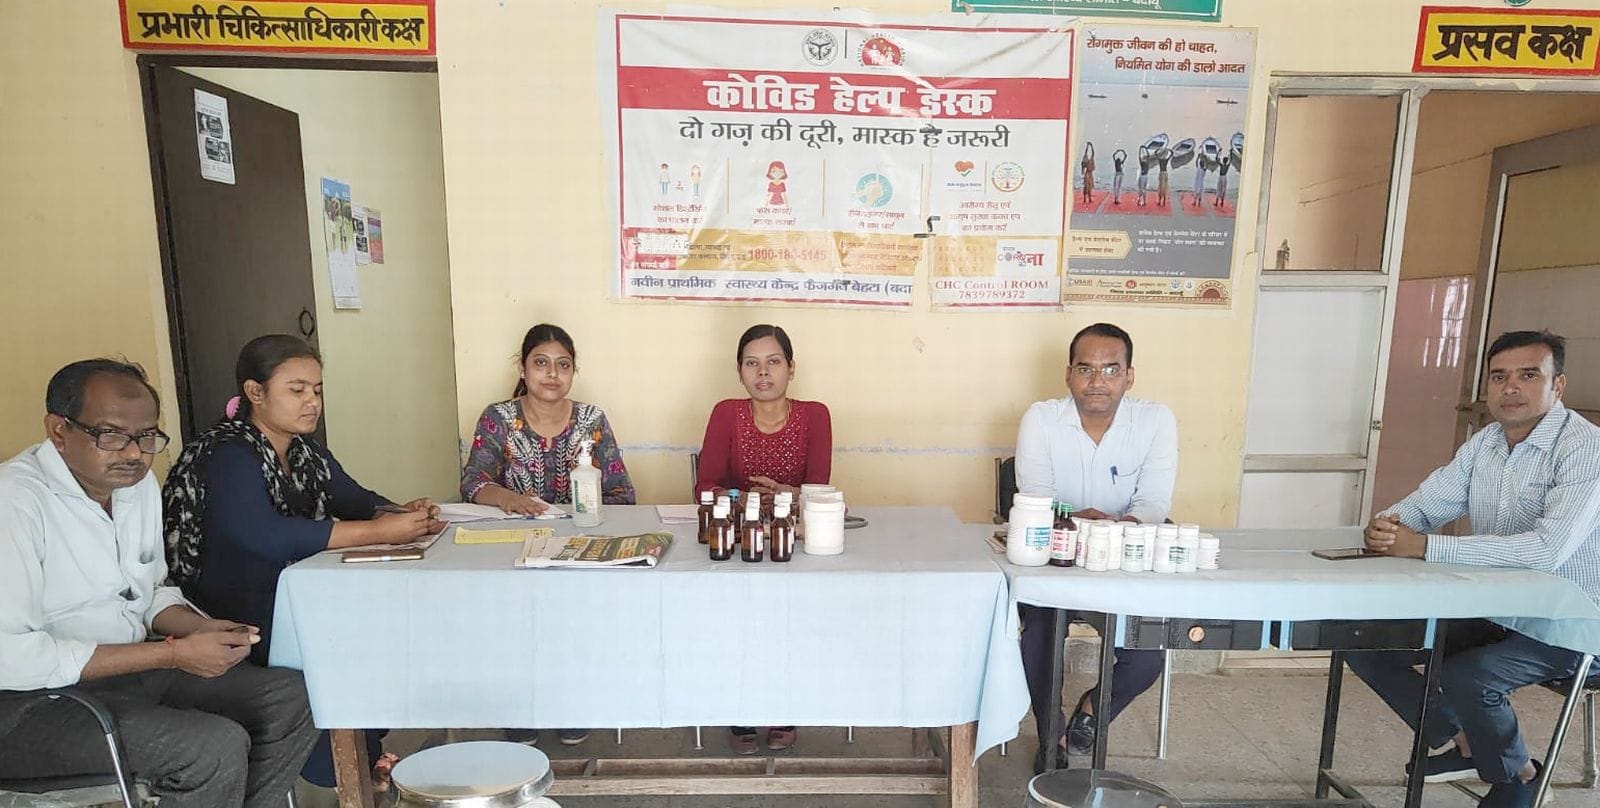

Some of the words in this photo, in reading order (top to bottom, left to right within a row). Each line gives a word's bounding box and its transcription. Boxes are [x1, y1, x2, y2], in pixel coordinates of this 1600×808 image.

[137, 4, 213, 39] प्रभारी
[215, 5, 381, 43] चिकित्साधिकारी
[381, 17, 425, 45] कक्ष
[1087, 36, 1124, 54] रोगमुक्त
[1126, 36, 1156, 51] जीवन
[1158, 37, 1172, 52] की
[1175, 38, 1185, 53] हो
[1188, 42, 1217, 54] चाहत,
[1432, 25, 1526, 61] प्रसव
[1527, 25, 1593, 64] कक्ष
[1115, 56, 1152, 71] नियमित
[1154, 58, 1176, 72] योग
[1177, 58, 1191, 72] की
[1193, 60, 1216, 73] डालो
[1217, 63, 1247, 74] आदत
[702, 72, 820, 111] कोविड
[829, 76, 906, 113] हेल्प
[914, 80, 998, 117] डेस्क
[679, 116, 705, 140] दो
[711, 121, 754, 147] गज़
[760, 118, 793, 143] की
[799, 119, 843, 150] दूरी,
[852, 126, 918, 147] मास्क
[919, 123, 943, 148] है
[946, 125, 1011, 148] जरूरी
[631, 275, 664, 288] नवीन
[667, 275, 717, 289] प्राथमिक
[935, 280, 962, 290] CHC
[1011, 280, 1049, 290] ROOM
[959, 290, 1025, 299] 7839789372
